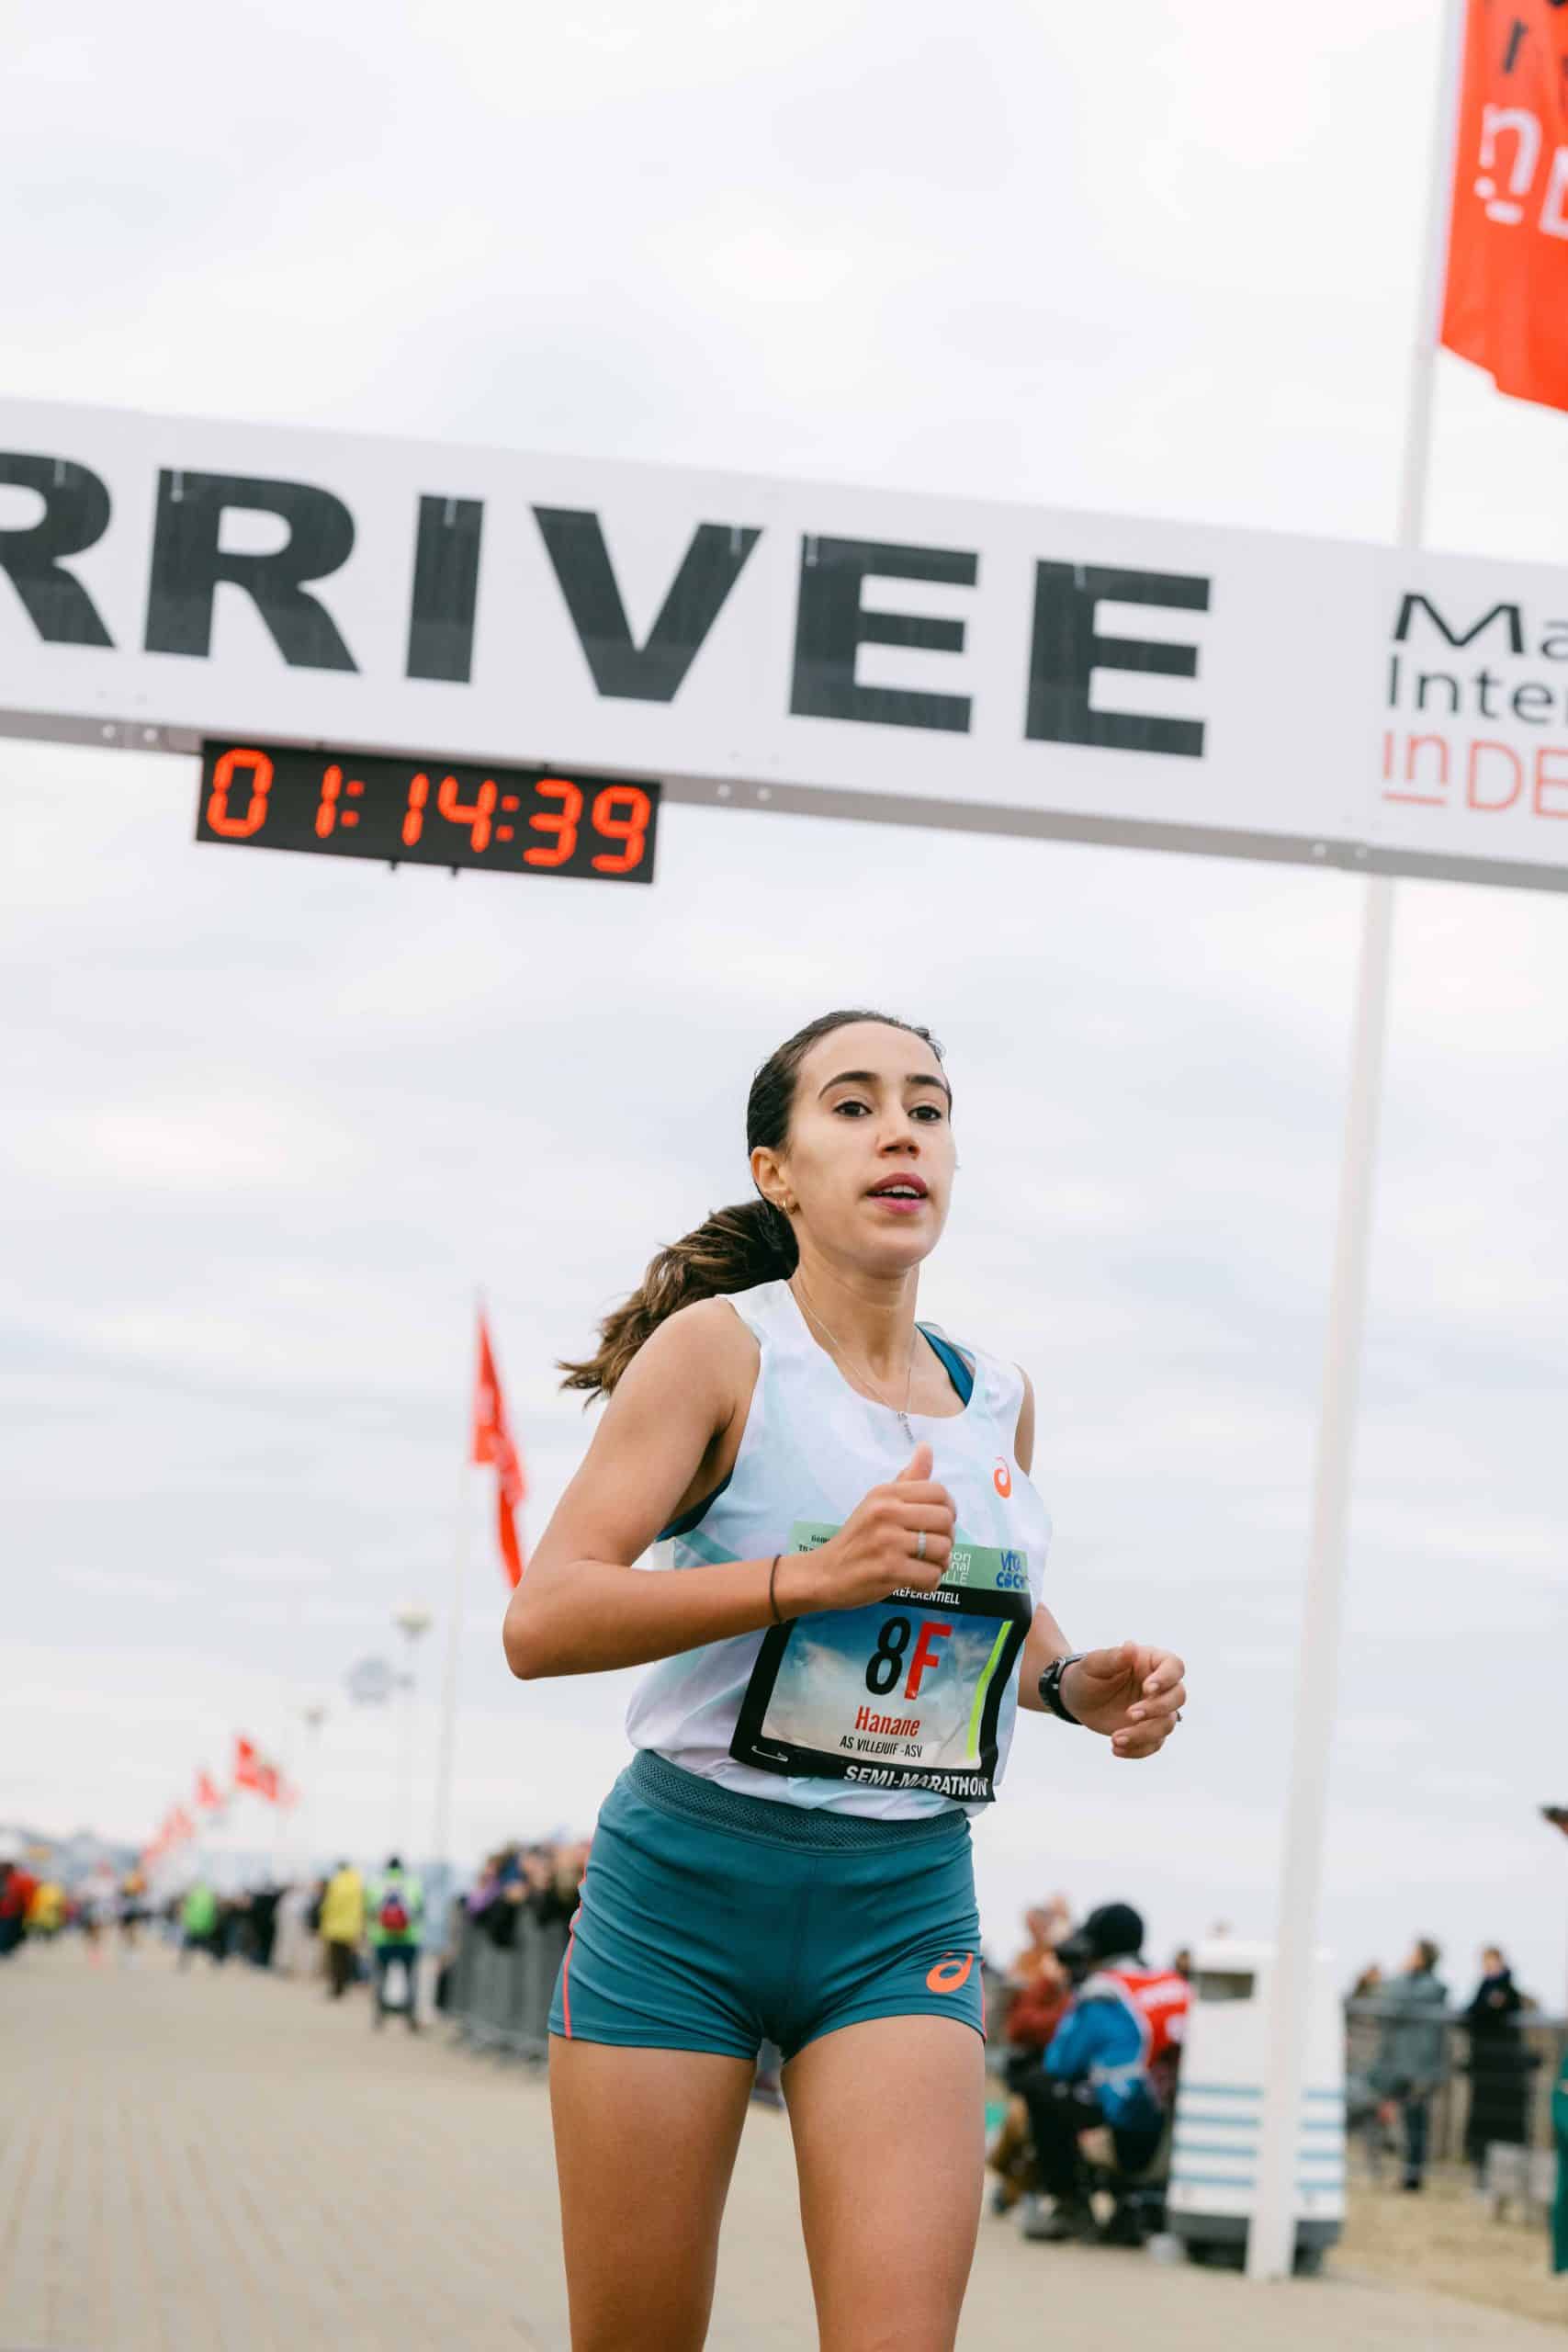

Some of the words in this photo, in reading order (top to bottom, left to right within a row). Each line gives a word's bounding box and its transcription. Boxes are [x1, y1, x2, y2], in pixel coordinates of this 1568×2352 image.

[1388, 653, 1568, 725] Inte
[864, 1616, 953, 1701] 8F
[855, 1705, 920, 1737] Hanane
[840, 1736, 853, 1749] AS
[857, 1738, 898, 1754] VILLEJUIF
[844, 1765, 988, 1797] SEMI-MARATHON
